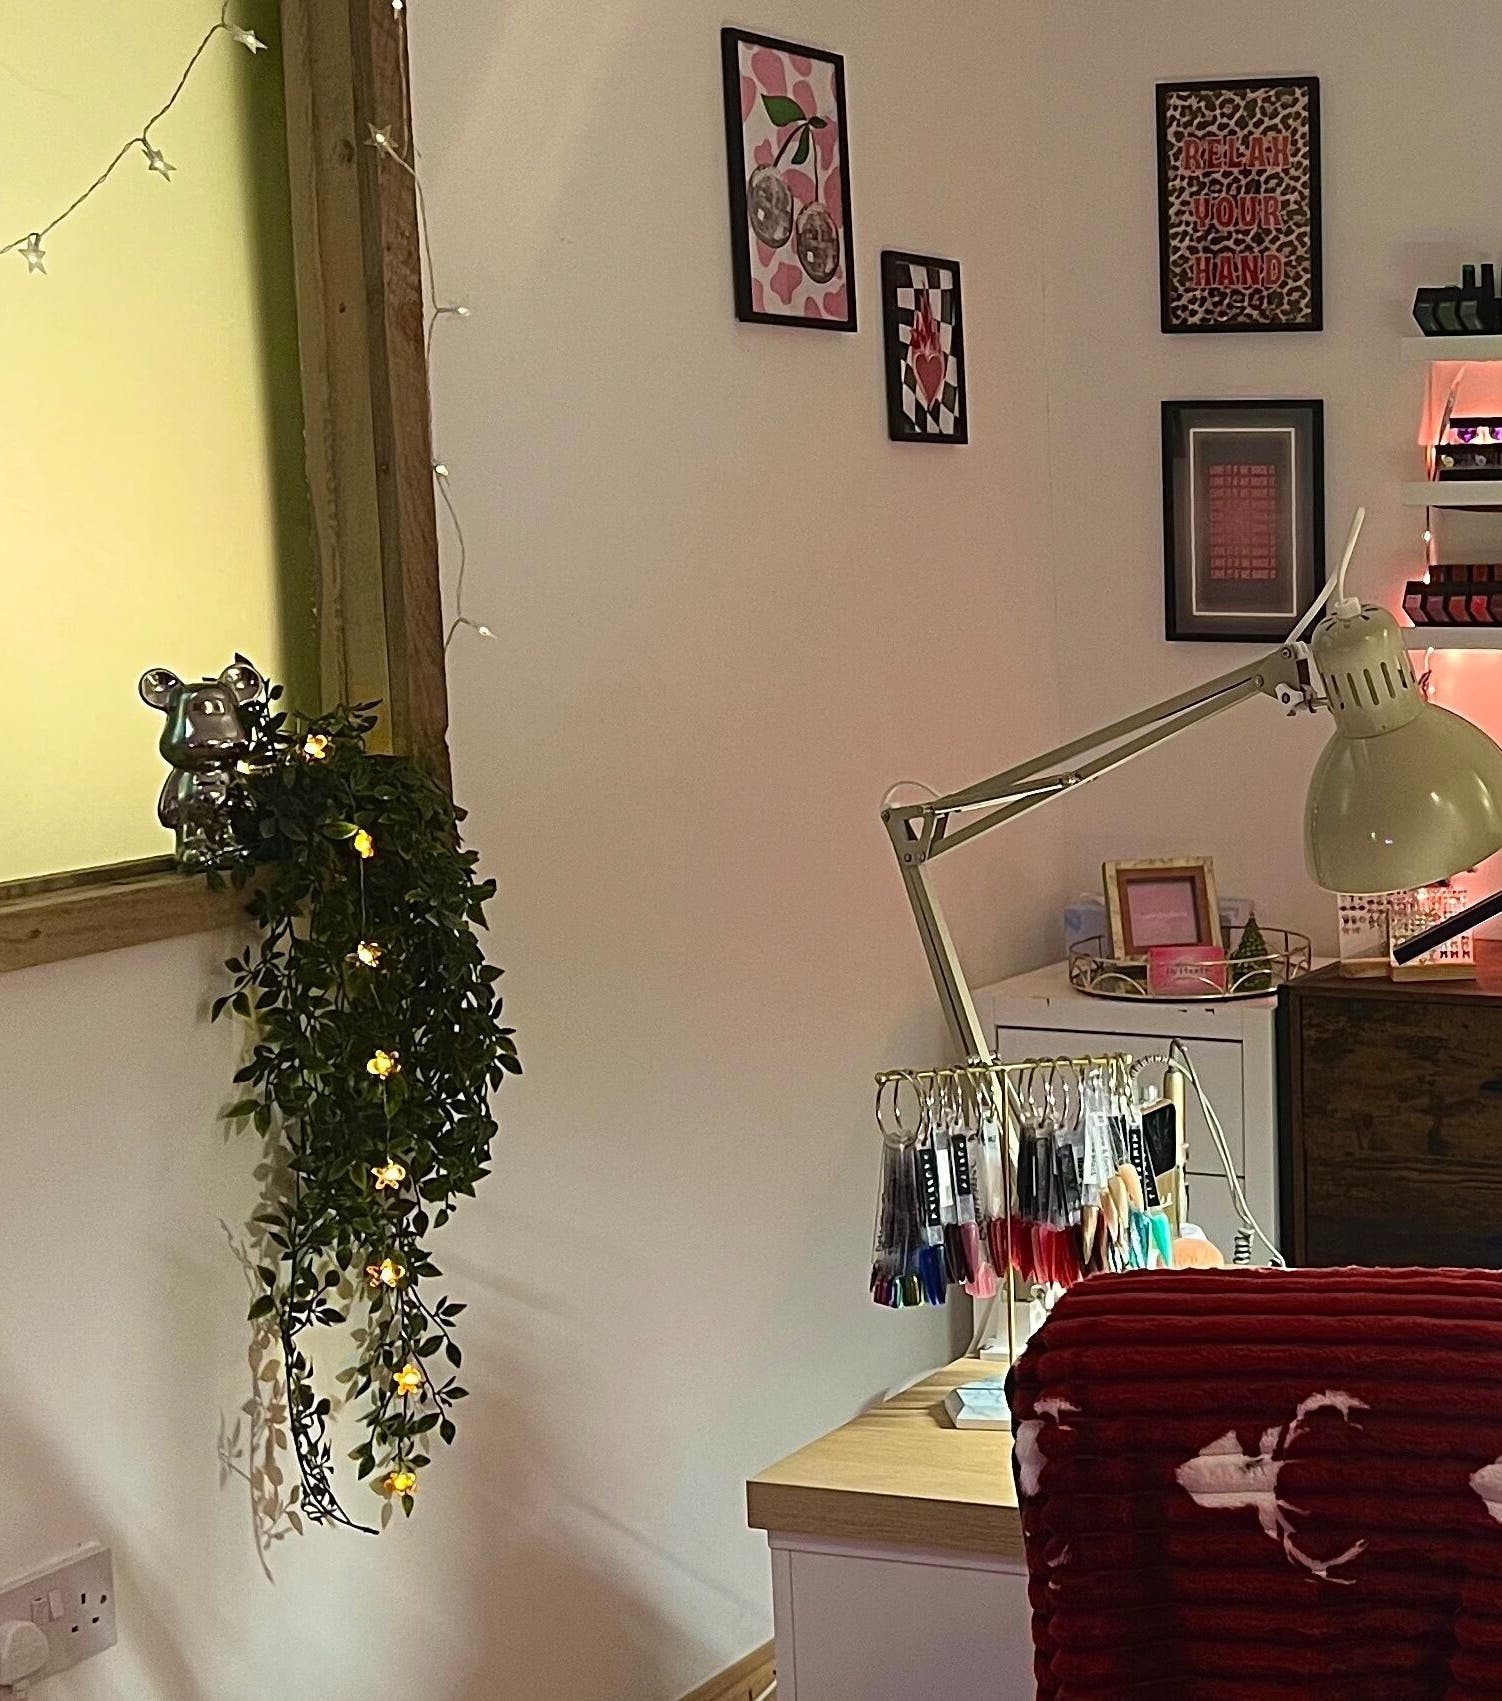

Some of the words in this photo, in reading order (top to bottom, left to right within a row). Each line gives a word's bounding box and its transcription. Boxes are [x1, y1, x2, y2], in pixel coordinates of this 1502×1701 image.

[1181, 135, 1291, 172] RELAX
[1191, 194, 1284, 230] YOUR
[1192, 252, 1286, 288] HAND
